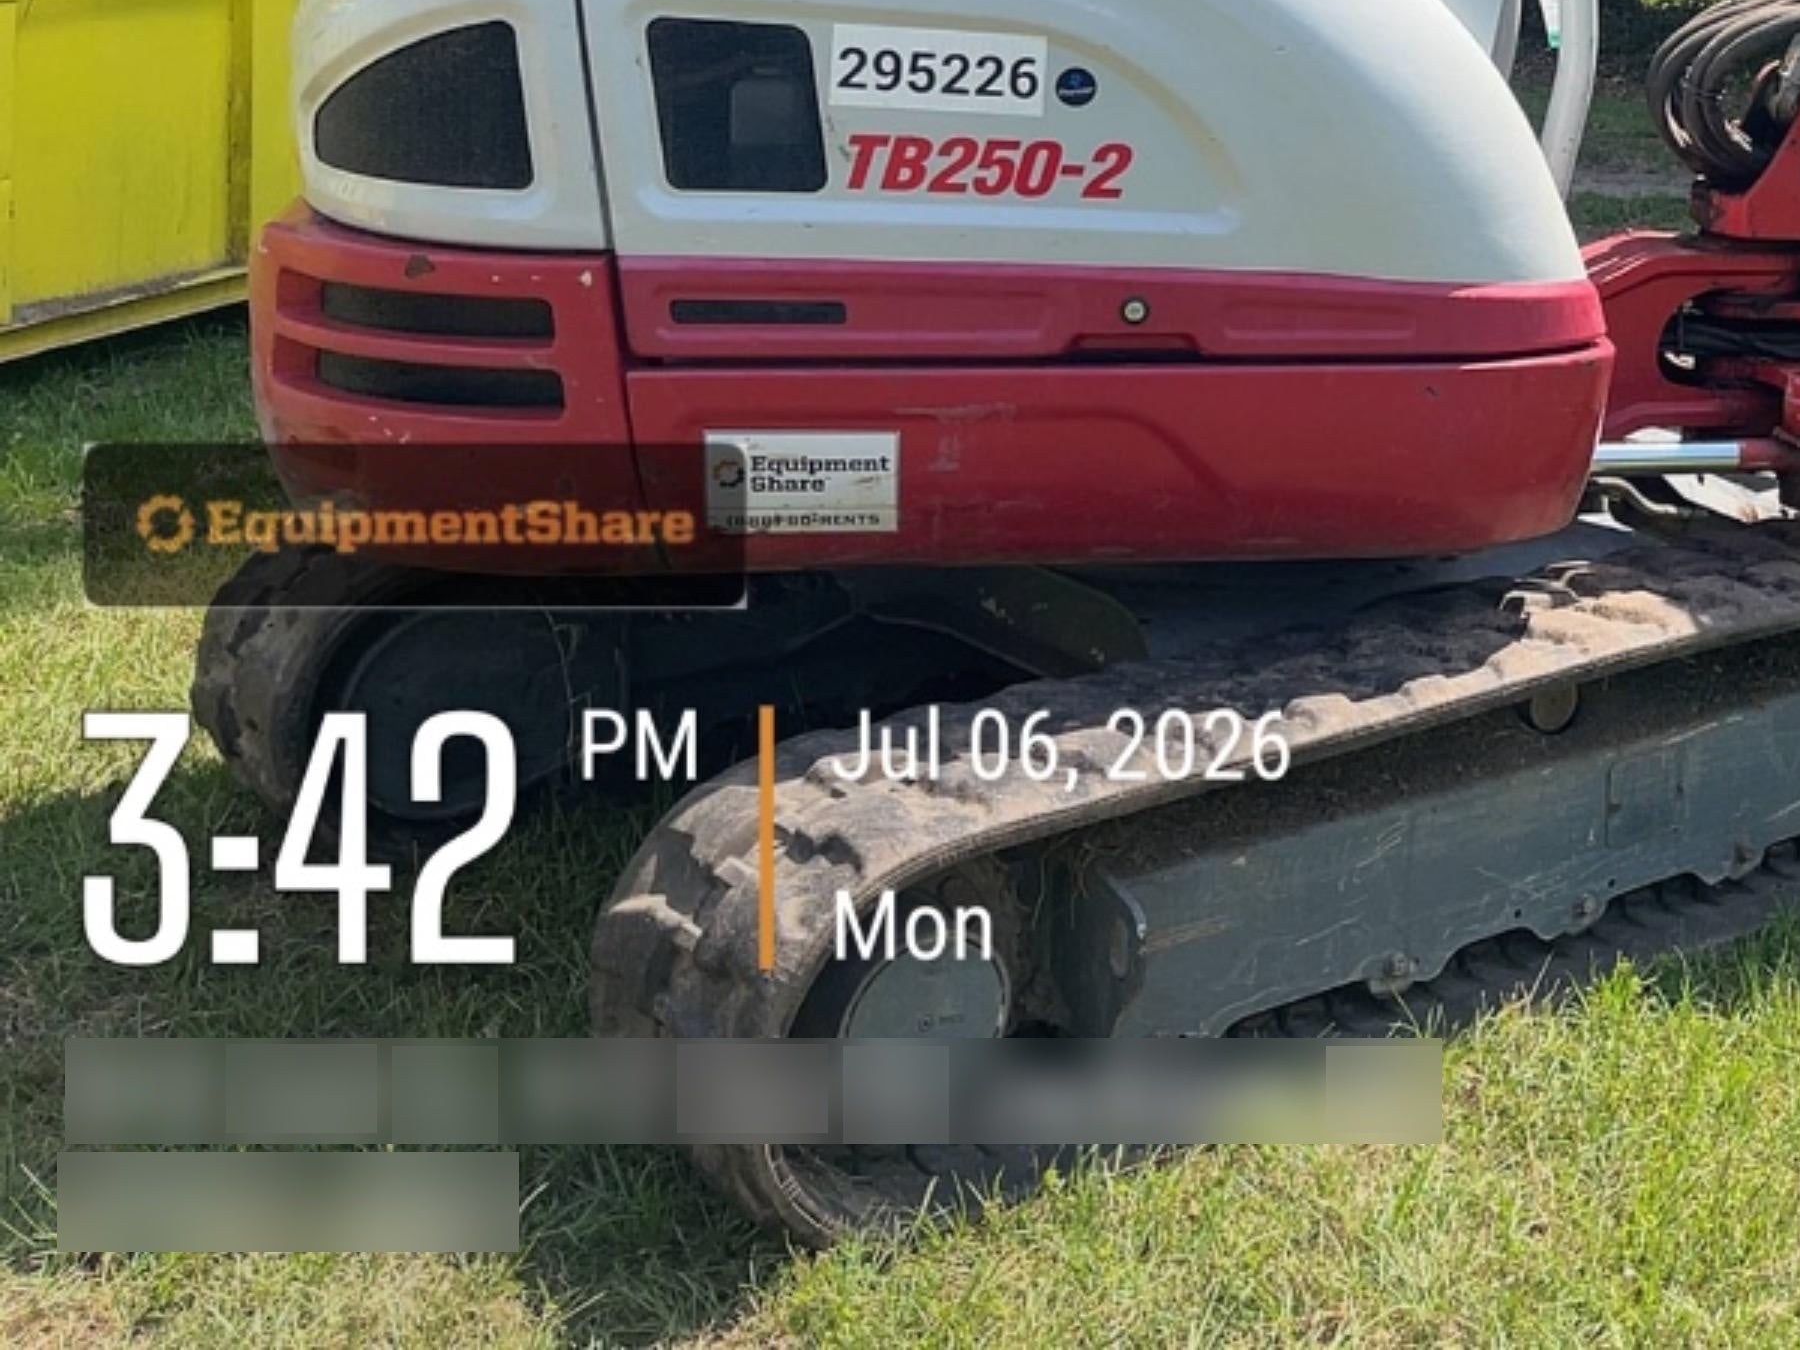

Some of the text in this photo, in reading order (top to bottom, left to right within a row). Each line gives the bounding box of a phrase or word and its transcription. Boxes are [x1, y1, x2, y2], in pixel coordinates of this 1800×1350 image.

[837, 46, 1040, 100] 295226
[845, 134, 1134, 199] TB250-2
[750, 455, 890, 475] Equipment
[751, 476, 826, 493] Share
